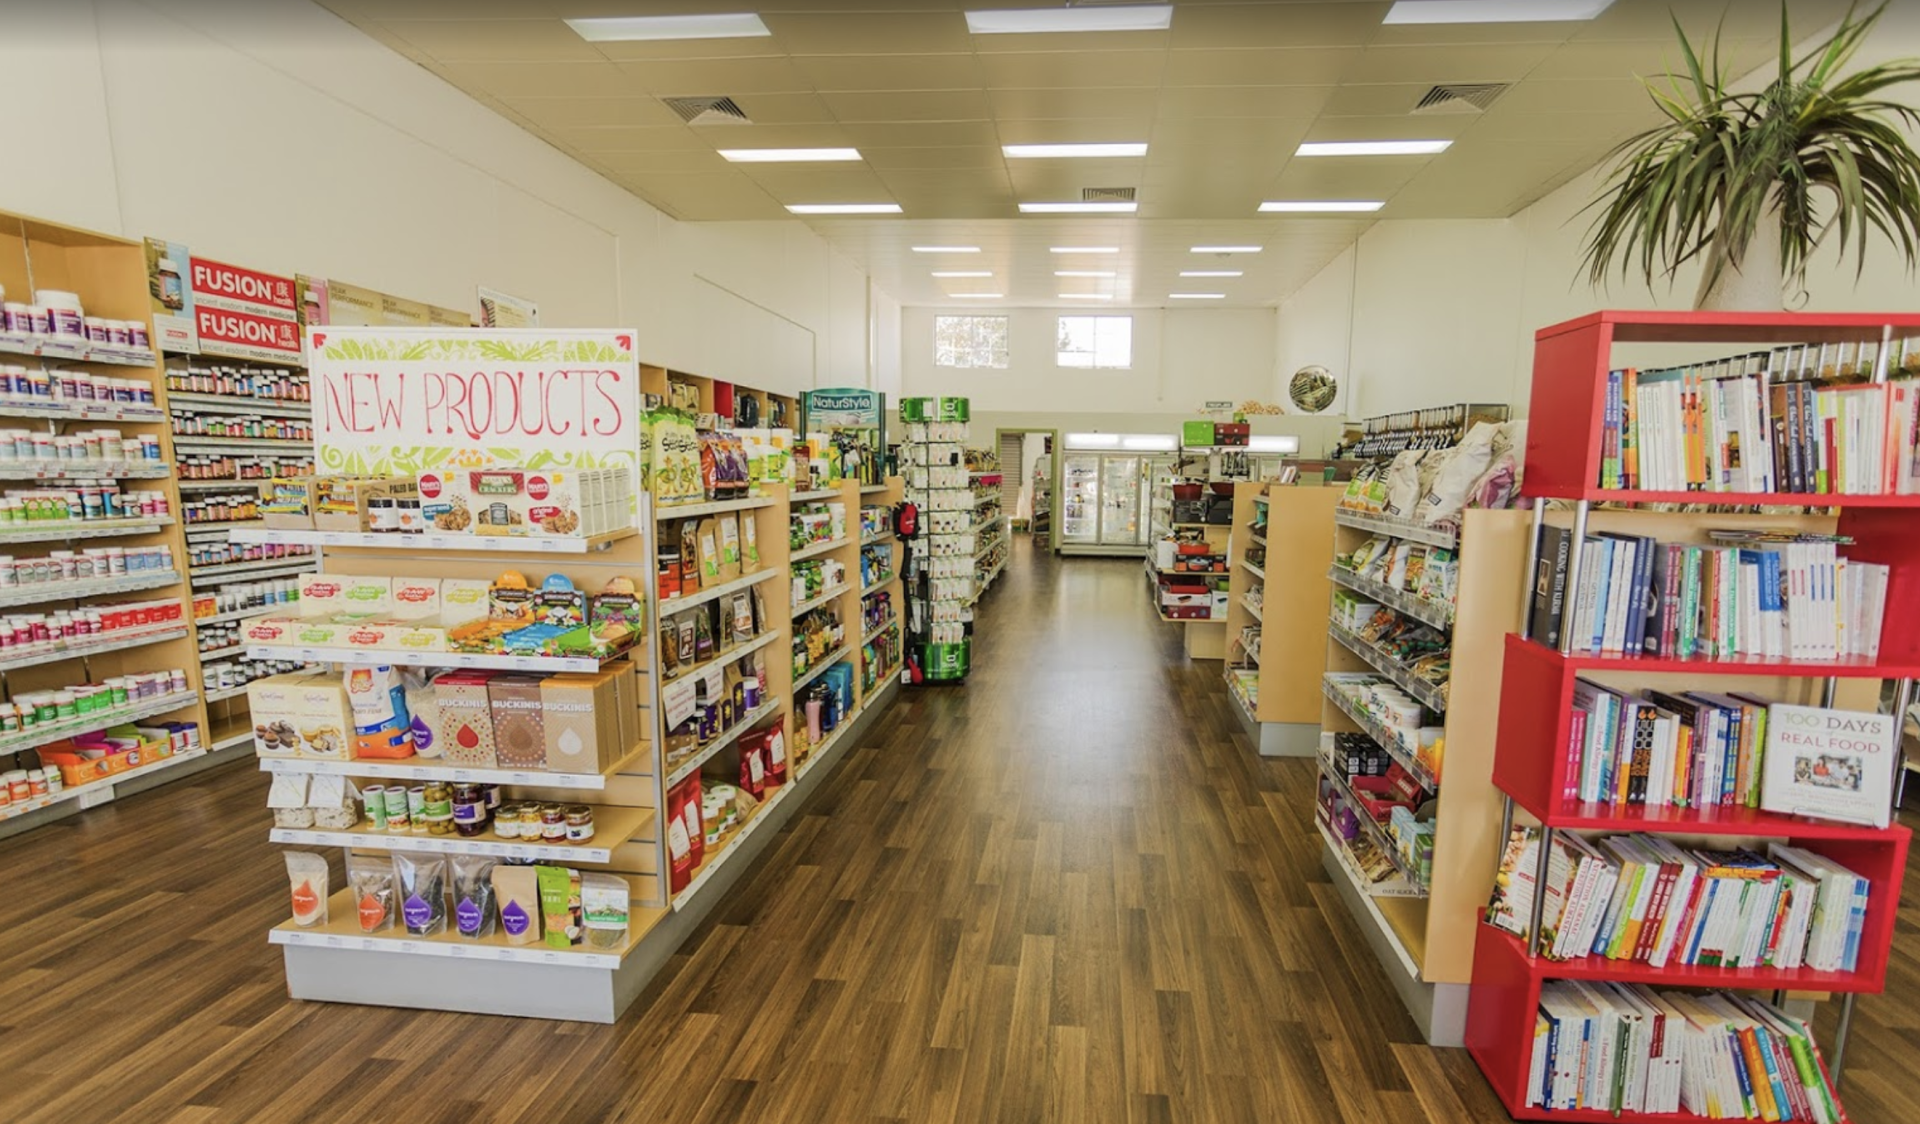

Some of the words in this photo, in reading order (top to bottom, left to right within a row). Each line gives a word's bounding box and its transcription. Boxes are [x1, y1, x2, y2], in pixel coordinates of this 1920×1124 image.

[194, 265, 272, 300] FUSION
[245, 306, 268, 316] modern
[269, 310, 294, 320] medicine
[200, 313, 276, 343] FUSION
[250, 350, 272, 359] modern
[274, 353, 299, 362] medicine
[323, 372, 404, 433] NEW
[424, 370, 622, 440] PRODUCTS
[814, 396, 870, 409] NaturStyle
[438, 699, 488, 708] BUCKINIS
[492, 701, 542, 710] BUCKINIS
[543, 702, 592, 712] BUCKINIS
[1784, 712, 1819, 727] 100
[1826, 716, 1881, 734] DAYS
[1782, 732, 1824, 748] REAL
[1829, 738, 1880, 753] FOOD
[1583, 863, 1599, 901] NUTRITION
[1572, 903, 1586, 935] ALMANAC
[1601, 1042, 1609, 1057] Food
[1598, 1058, 1607, 1079] Allergy
